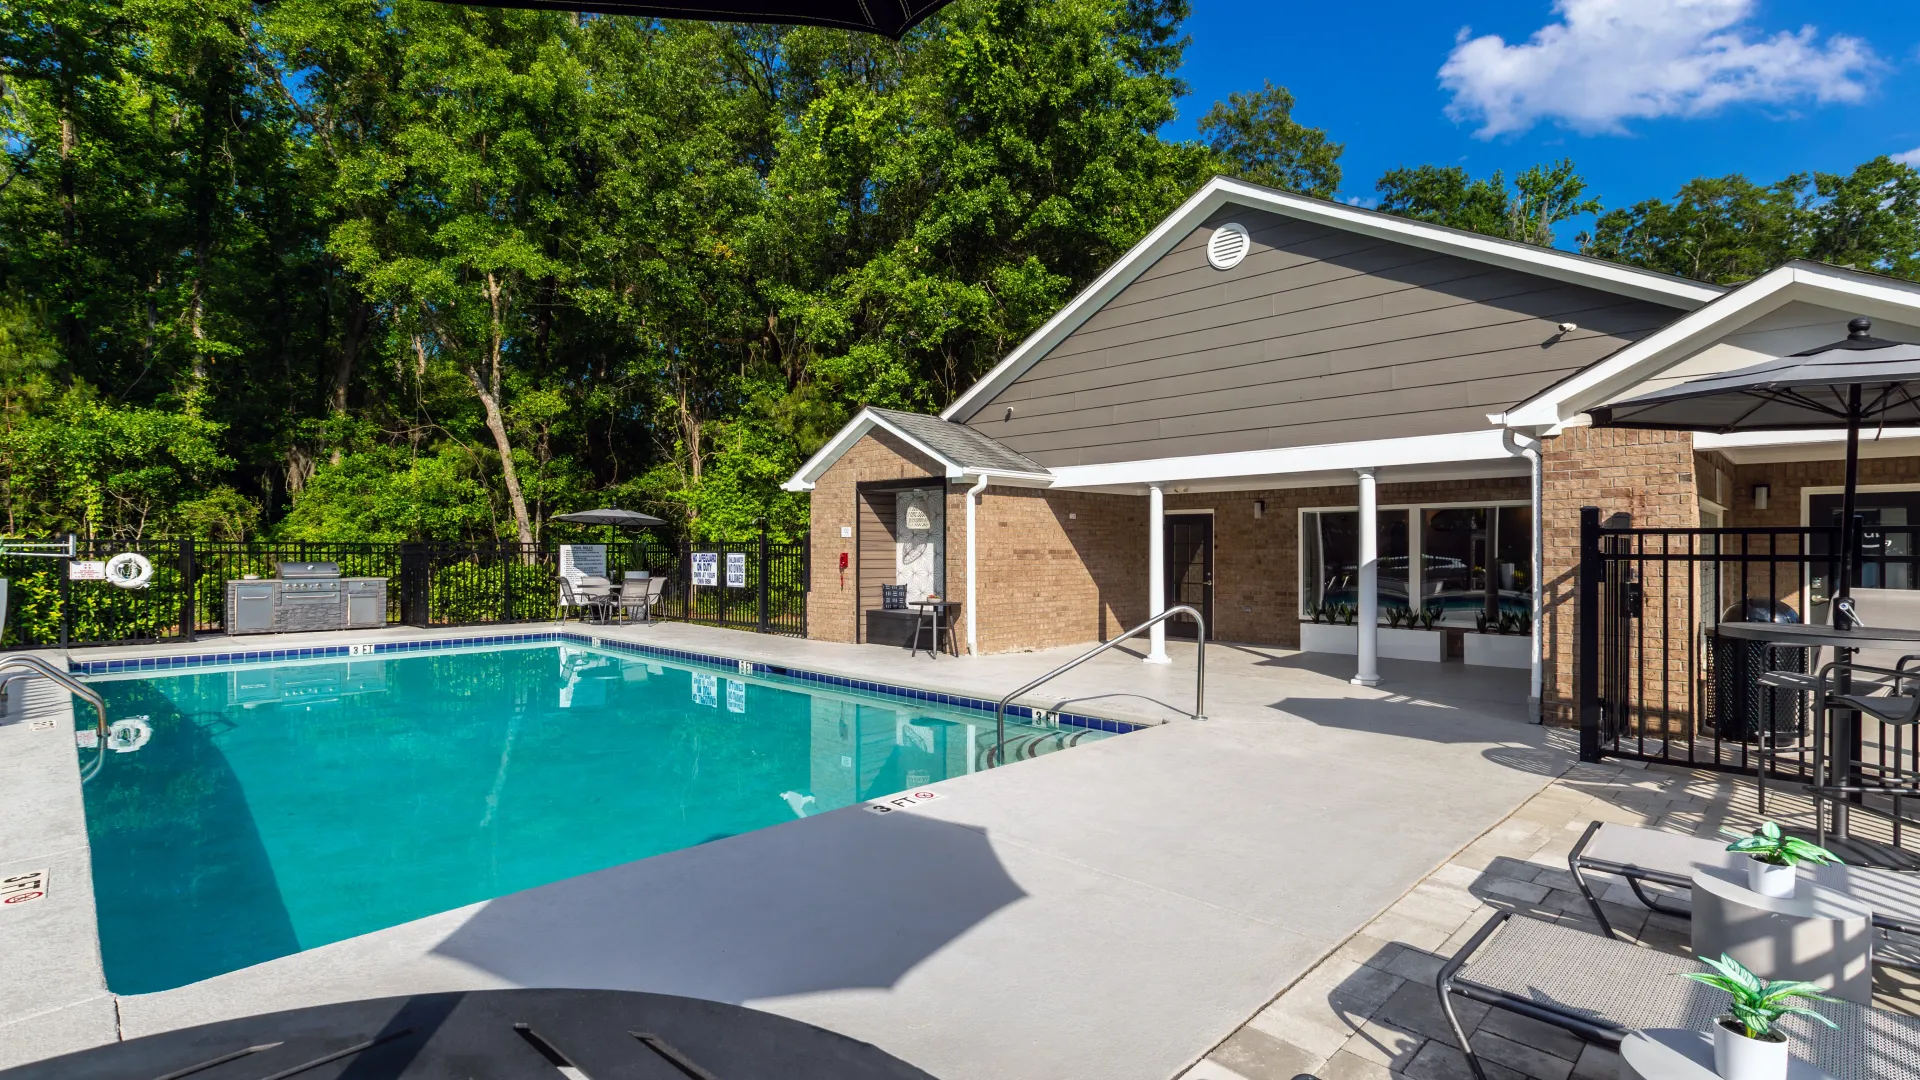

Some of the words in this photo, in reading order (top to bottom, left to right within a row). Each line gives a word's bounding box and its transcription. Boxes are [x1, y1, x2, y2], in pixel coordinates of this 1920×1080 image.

[692, 554, 698, 562] NO
[698, 554, 716, 562] LIFEGUARD
[696, 563, 702, 571] ON
[703, 563, 712, 572] DUTY
[728, 574, 744, 584] ALLOWED
[1036, 711, 1042, 725] 3
[890, 796, 916, 808] FT
